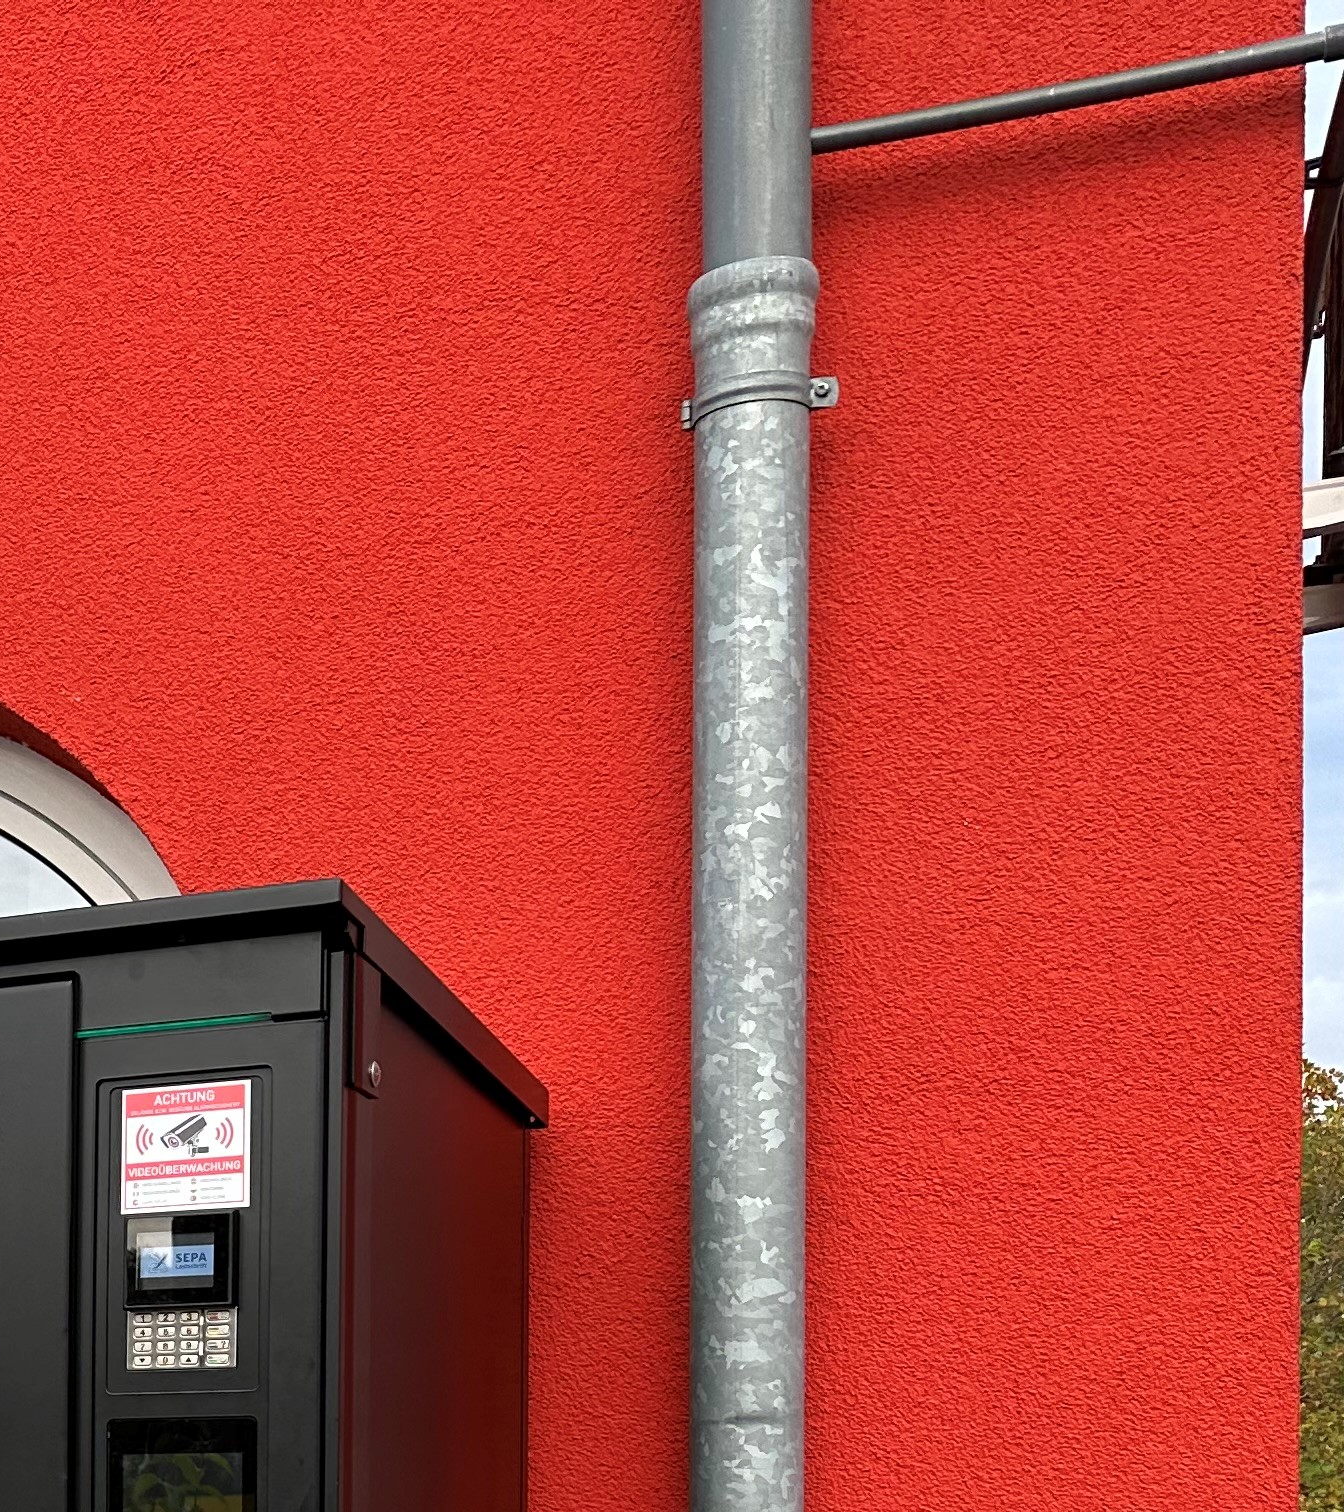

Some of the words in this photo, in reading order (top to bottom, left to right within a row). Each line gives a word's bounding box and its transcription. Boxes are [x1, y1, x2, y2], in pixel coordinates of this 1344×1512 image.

[153, 1089, 215, 1107] ACHTUNG
[128, 1160, 241, 1178] VIDEOÜBERWACHUNG
[176, 1252, 207, 1263] SEPA
